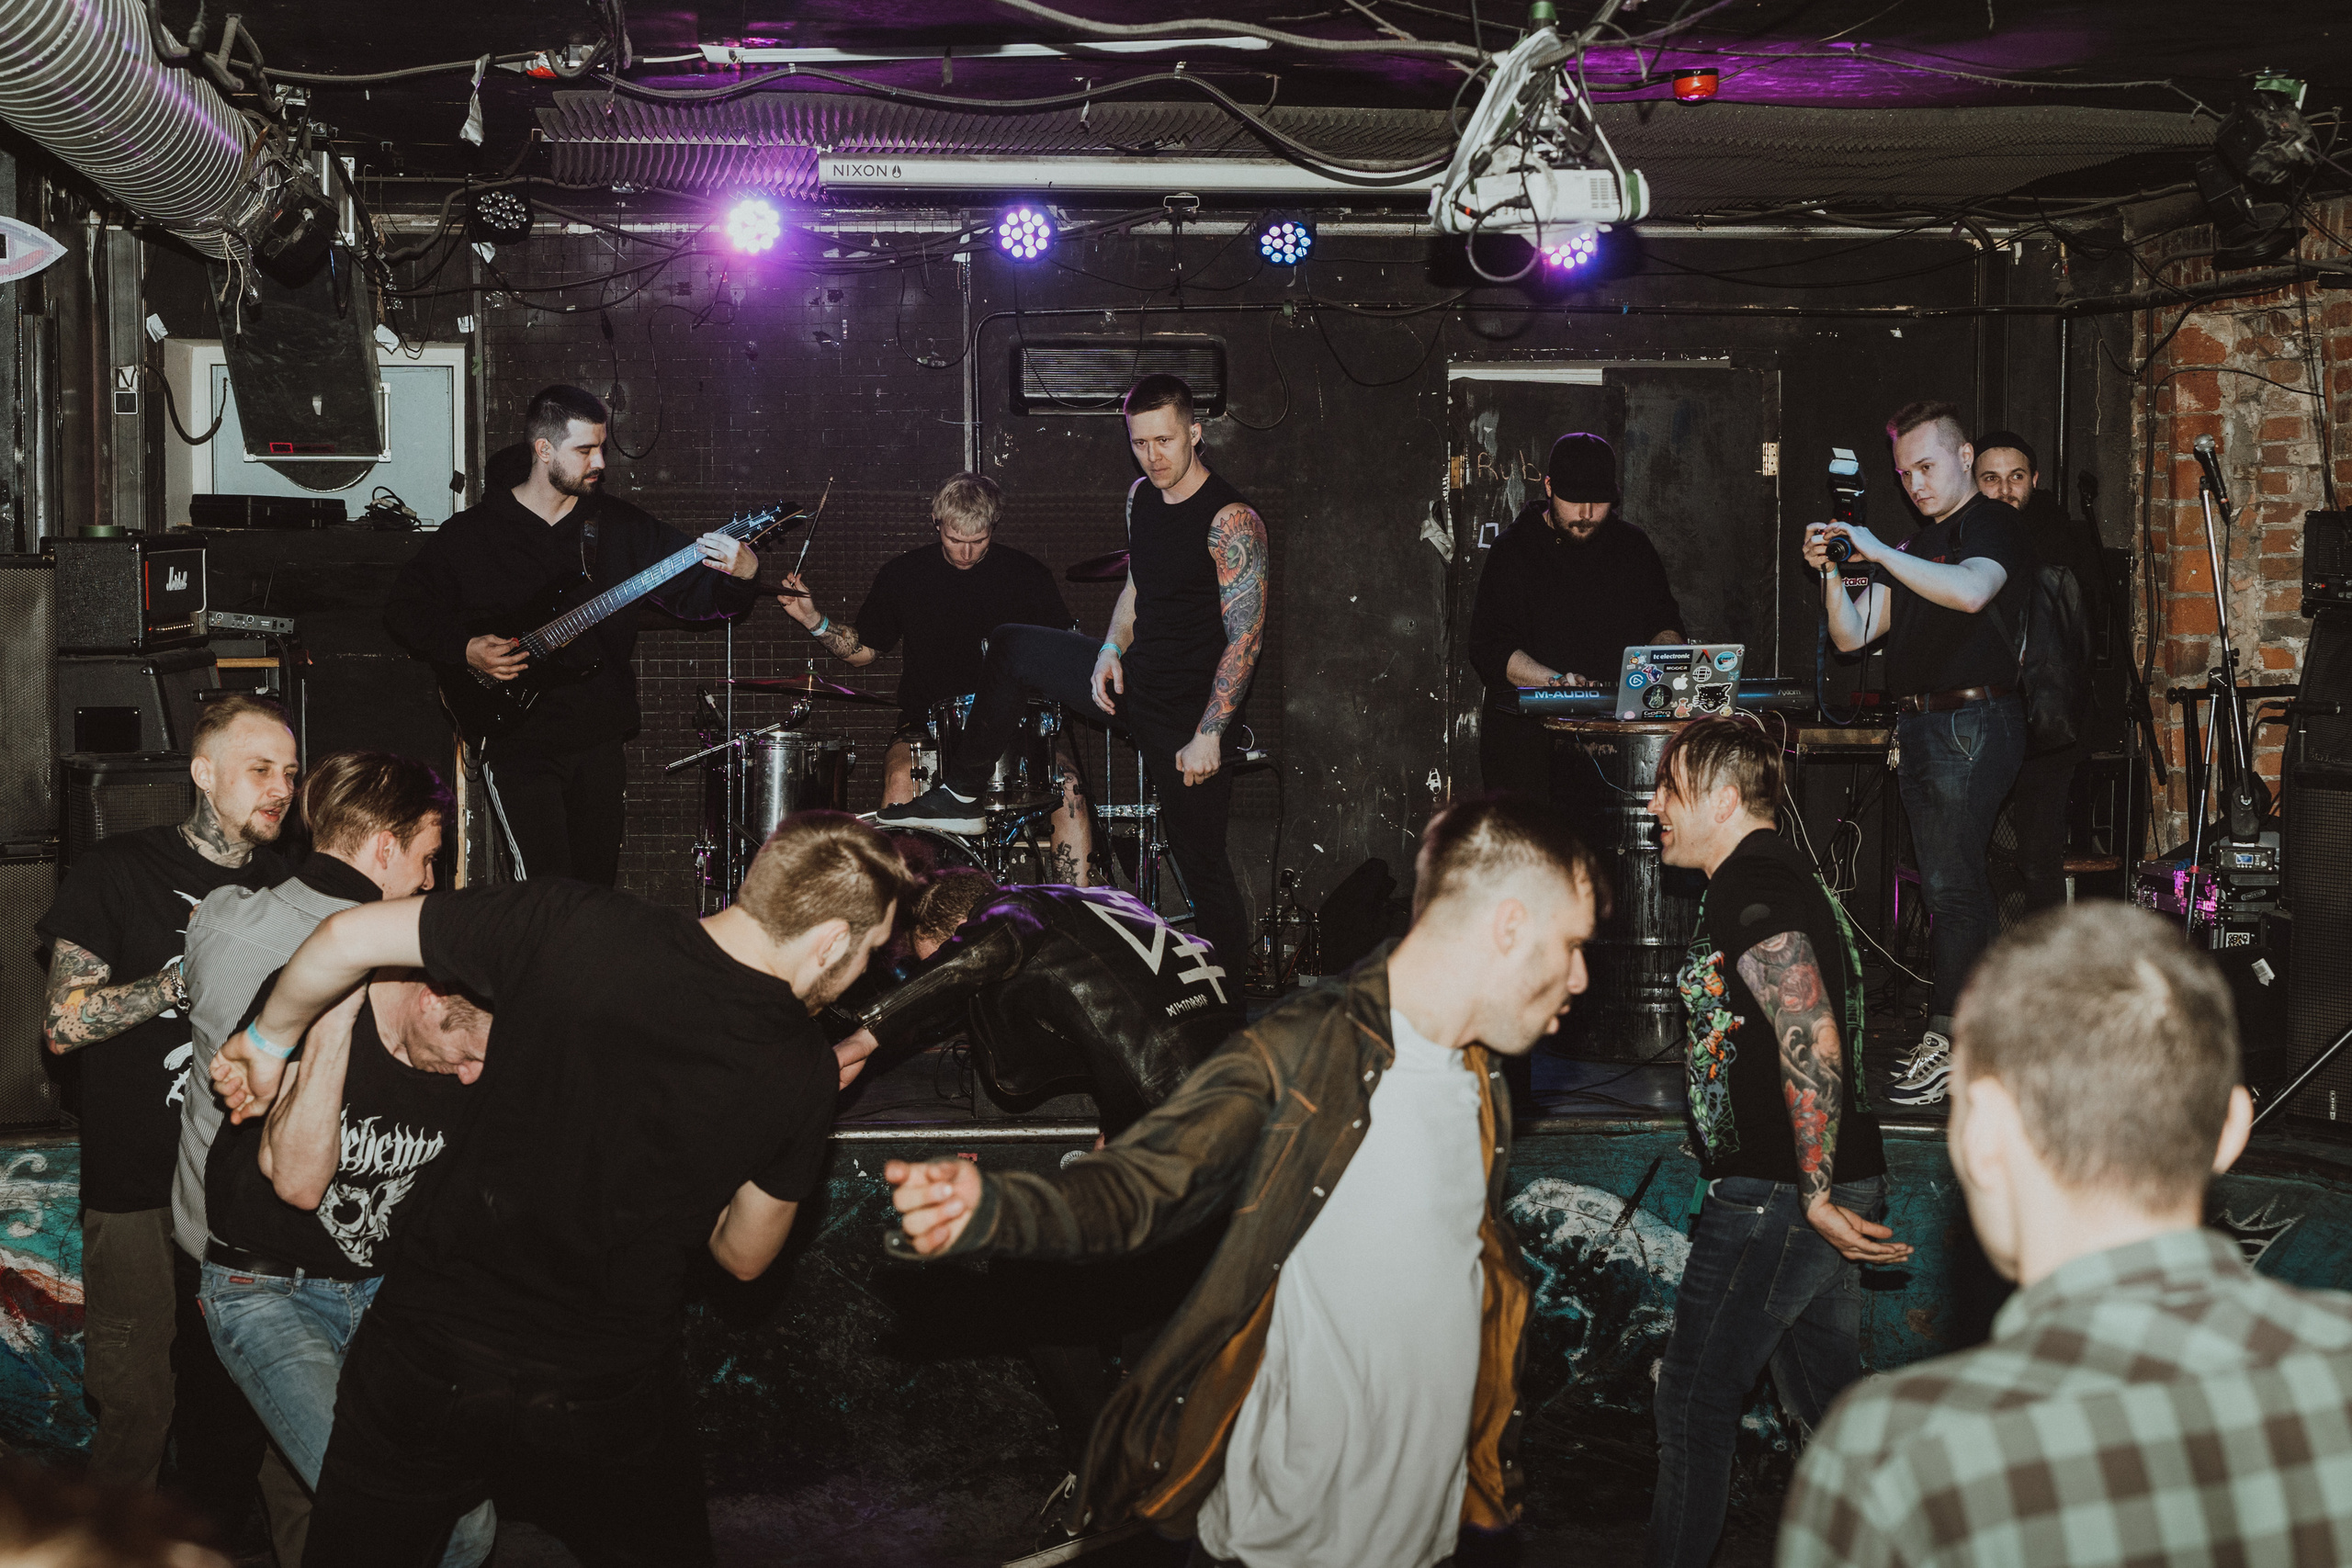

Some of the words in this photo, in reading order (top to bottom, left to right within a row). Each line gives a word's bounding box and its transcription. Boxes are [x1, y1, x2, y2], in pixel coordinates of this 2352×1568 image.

[832, 164, 888, 177] NIXON
[1476, 449, 1543, 482] Rub
[1659, 652, 1690, 660] electronic
[1534, 690, 1600, 699] M-AUDIO
[338, 1102, 447, 1179] ehemo
